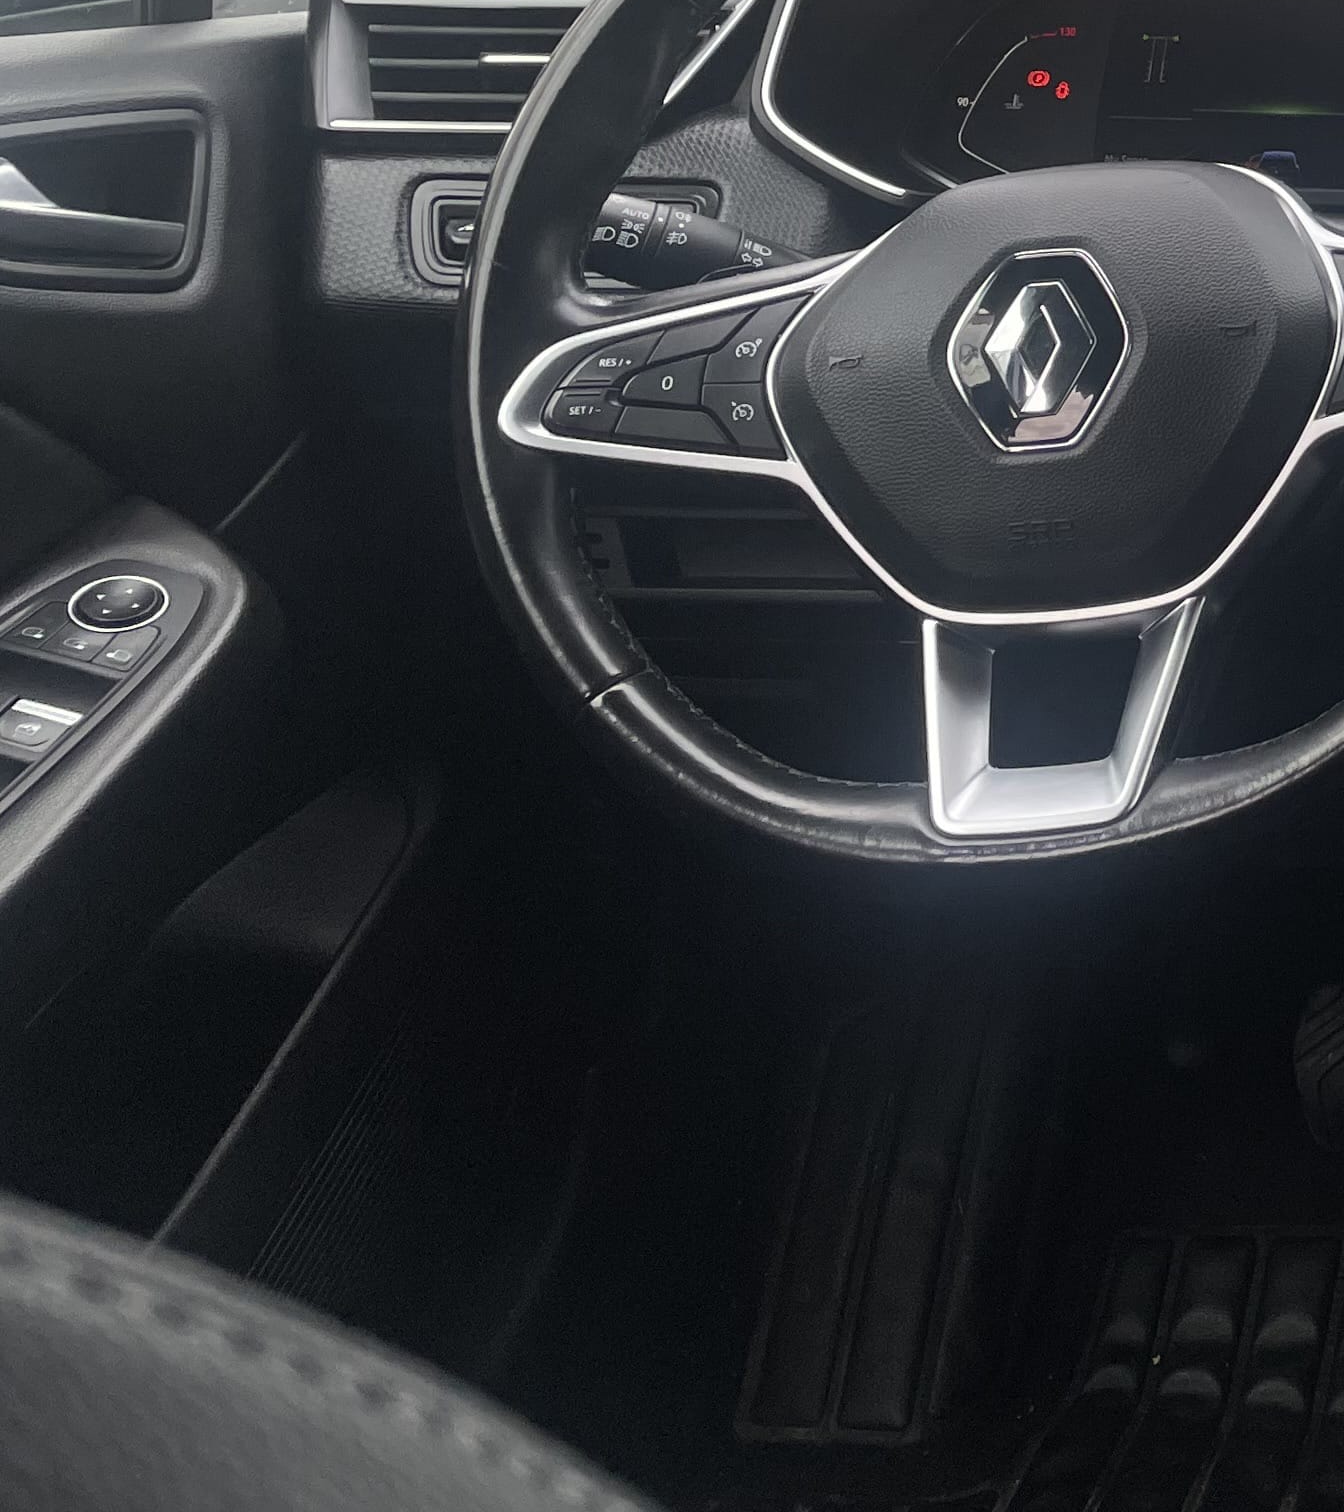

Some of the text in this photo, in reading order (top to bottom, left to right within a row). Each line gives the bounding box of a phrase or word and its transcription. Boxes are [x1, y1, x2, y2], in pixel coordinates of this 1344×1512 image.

[1059, 26, 1077, 37] 130
[957, 96, 969, 107] 90
[621, 206, 650, 220] AUTO
[598, 357, 617, 368] RES
[568, 405, 587, 416] SET
